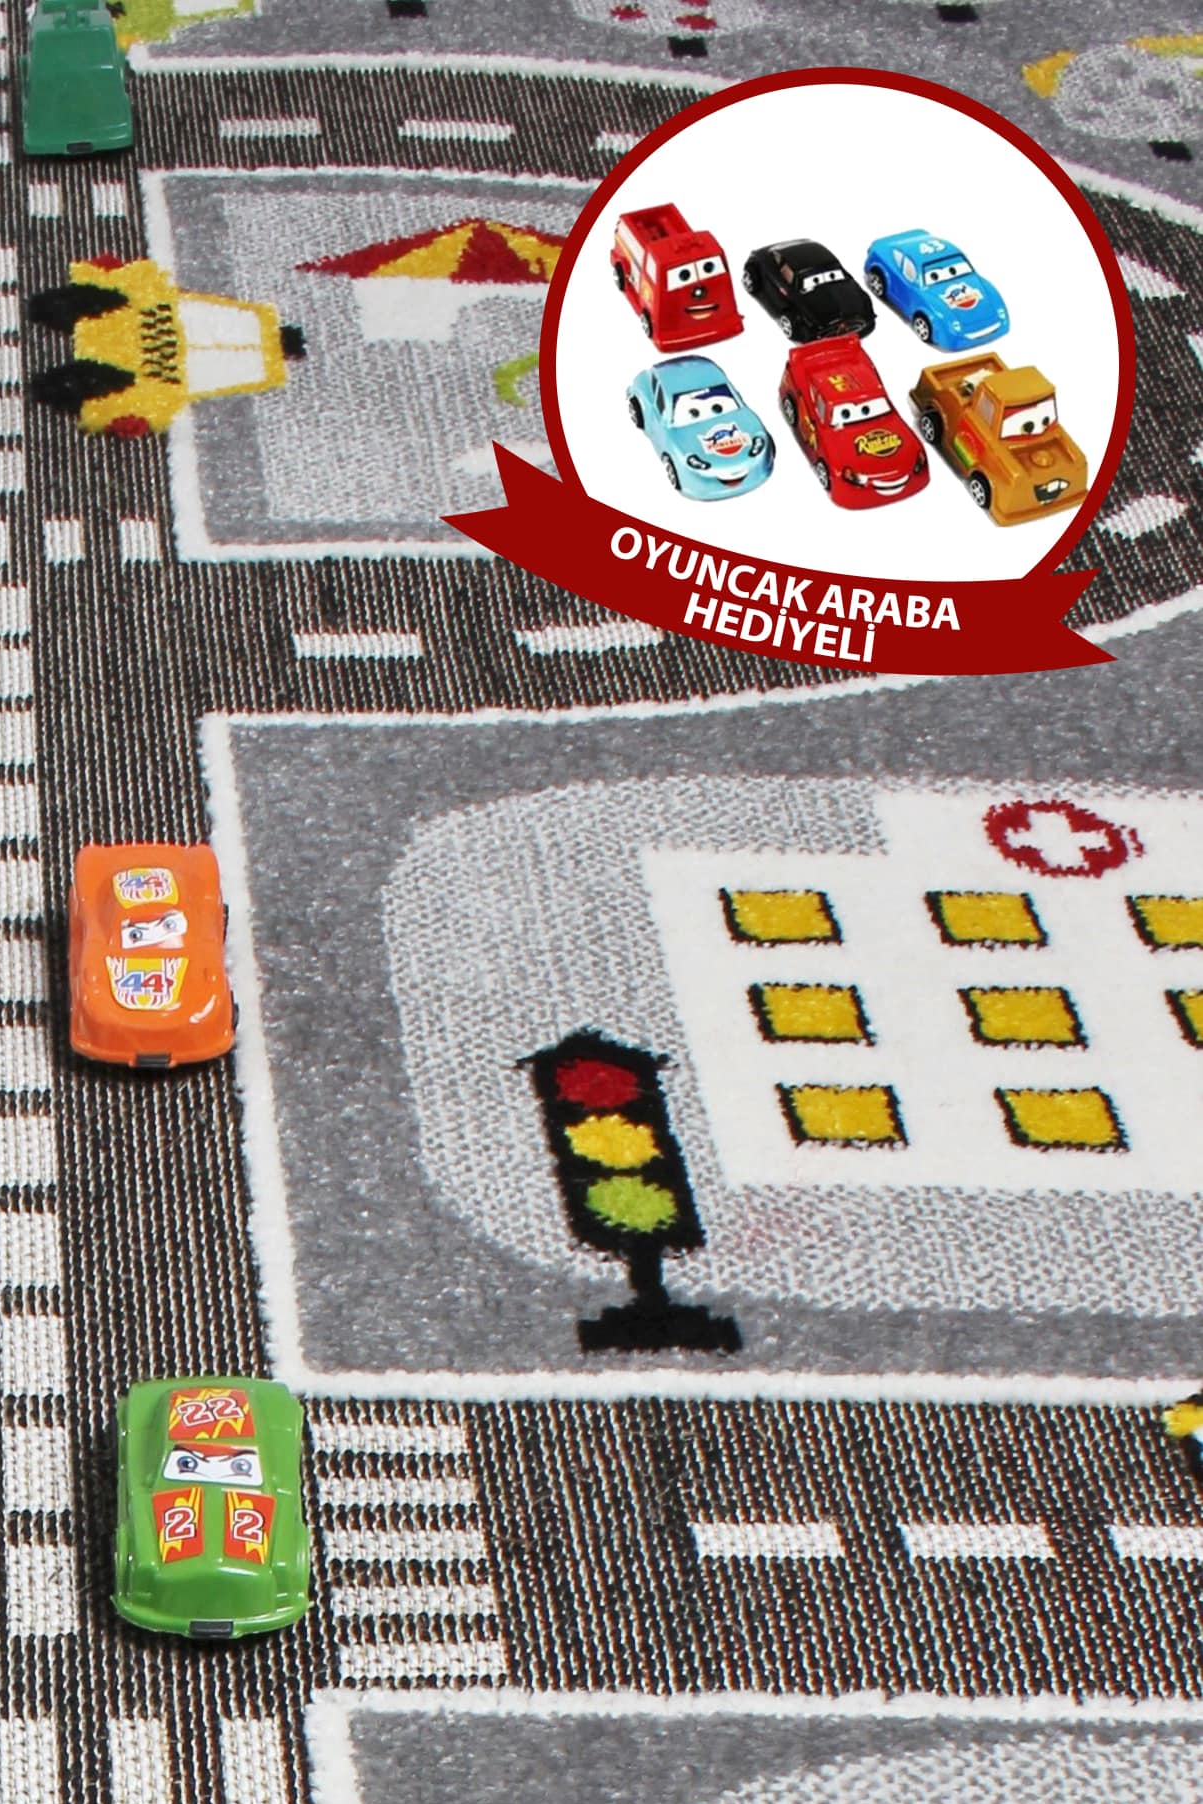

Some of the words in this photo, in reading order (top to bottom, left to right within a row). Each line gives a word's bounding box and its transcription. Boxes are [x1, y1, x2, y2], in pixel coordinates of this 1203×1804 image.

[122, 873, 165, 890] 44
[119, 971, 166, 994] 44
[177, 1397, 245, 1428] 22
